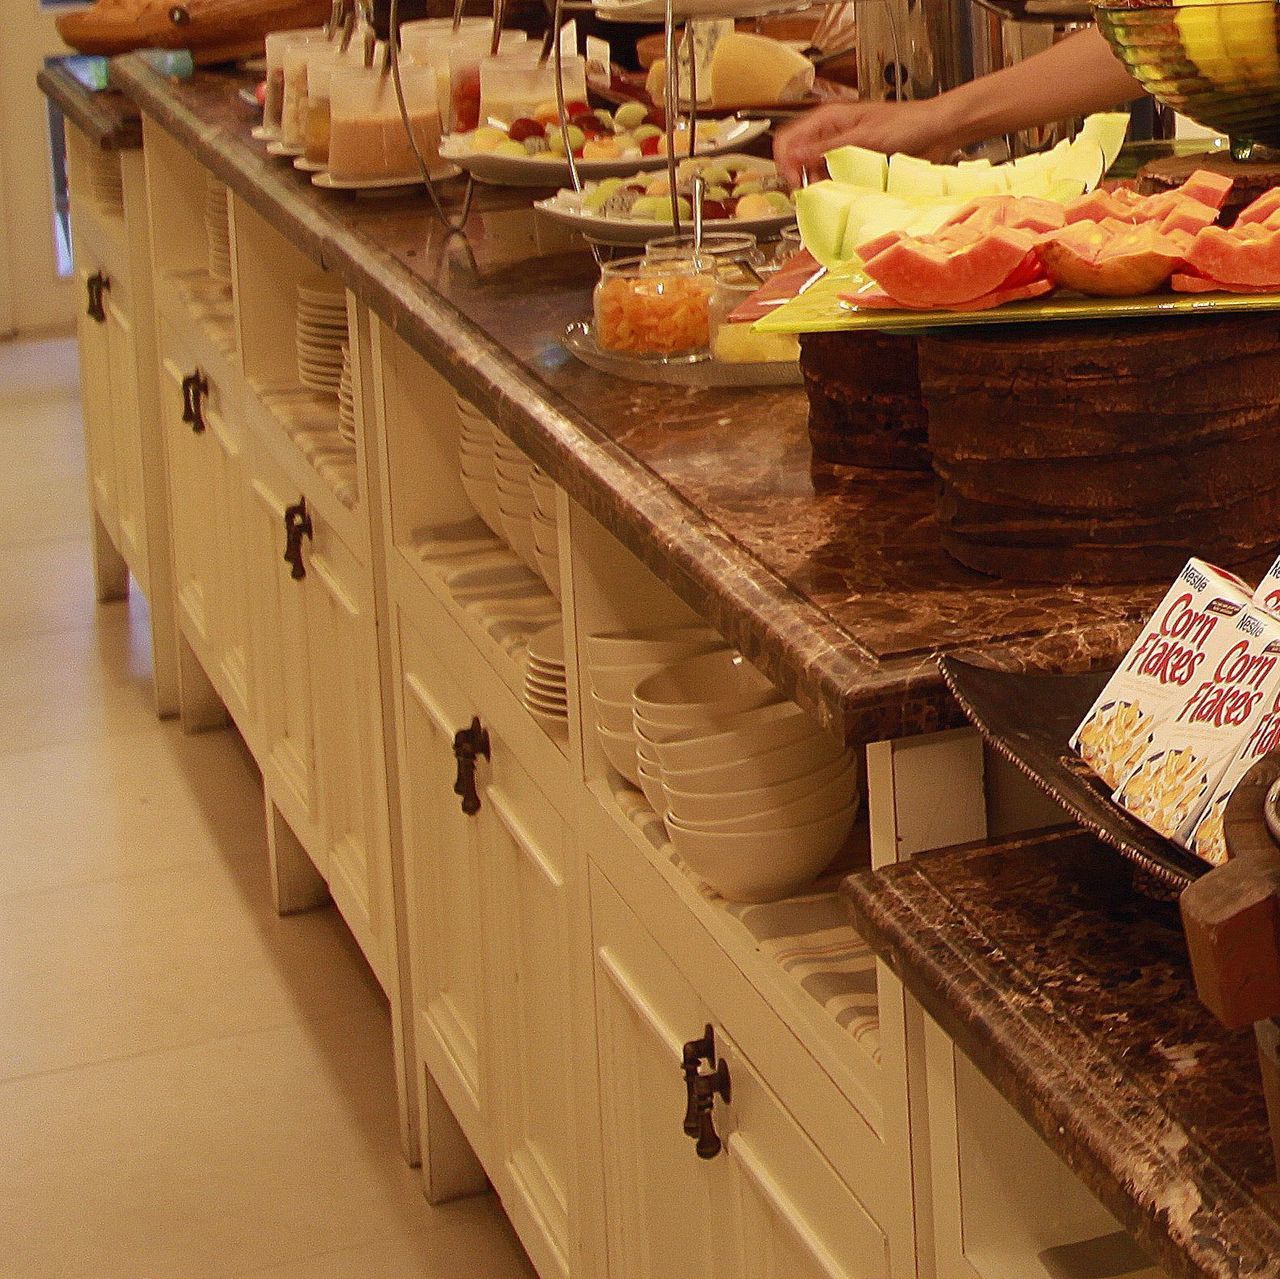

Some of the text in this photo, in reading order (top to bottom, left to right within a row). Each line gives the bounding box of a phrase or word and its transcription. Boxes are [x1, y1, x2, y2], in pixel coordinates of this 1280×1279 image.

[1181, 563, 1210, 593] Nestlé
[1160, 593, 1219, 651] Corn
[1125, 632, 1206, 686] Flakes
[1214, 639, 1278, 692] Corn
[1175, 682, 1264, 728] Flakes
